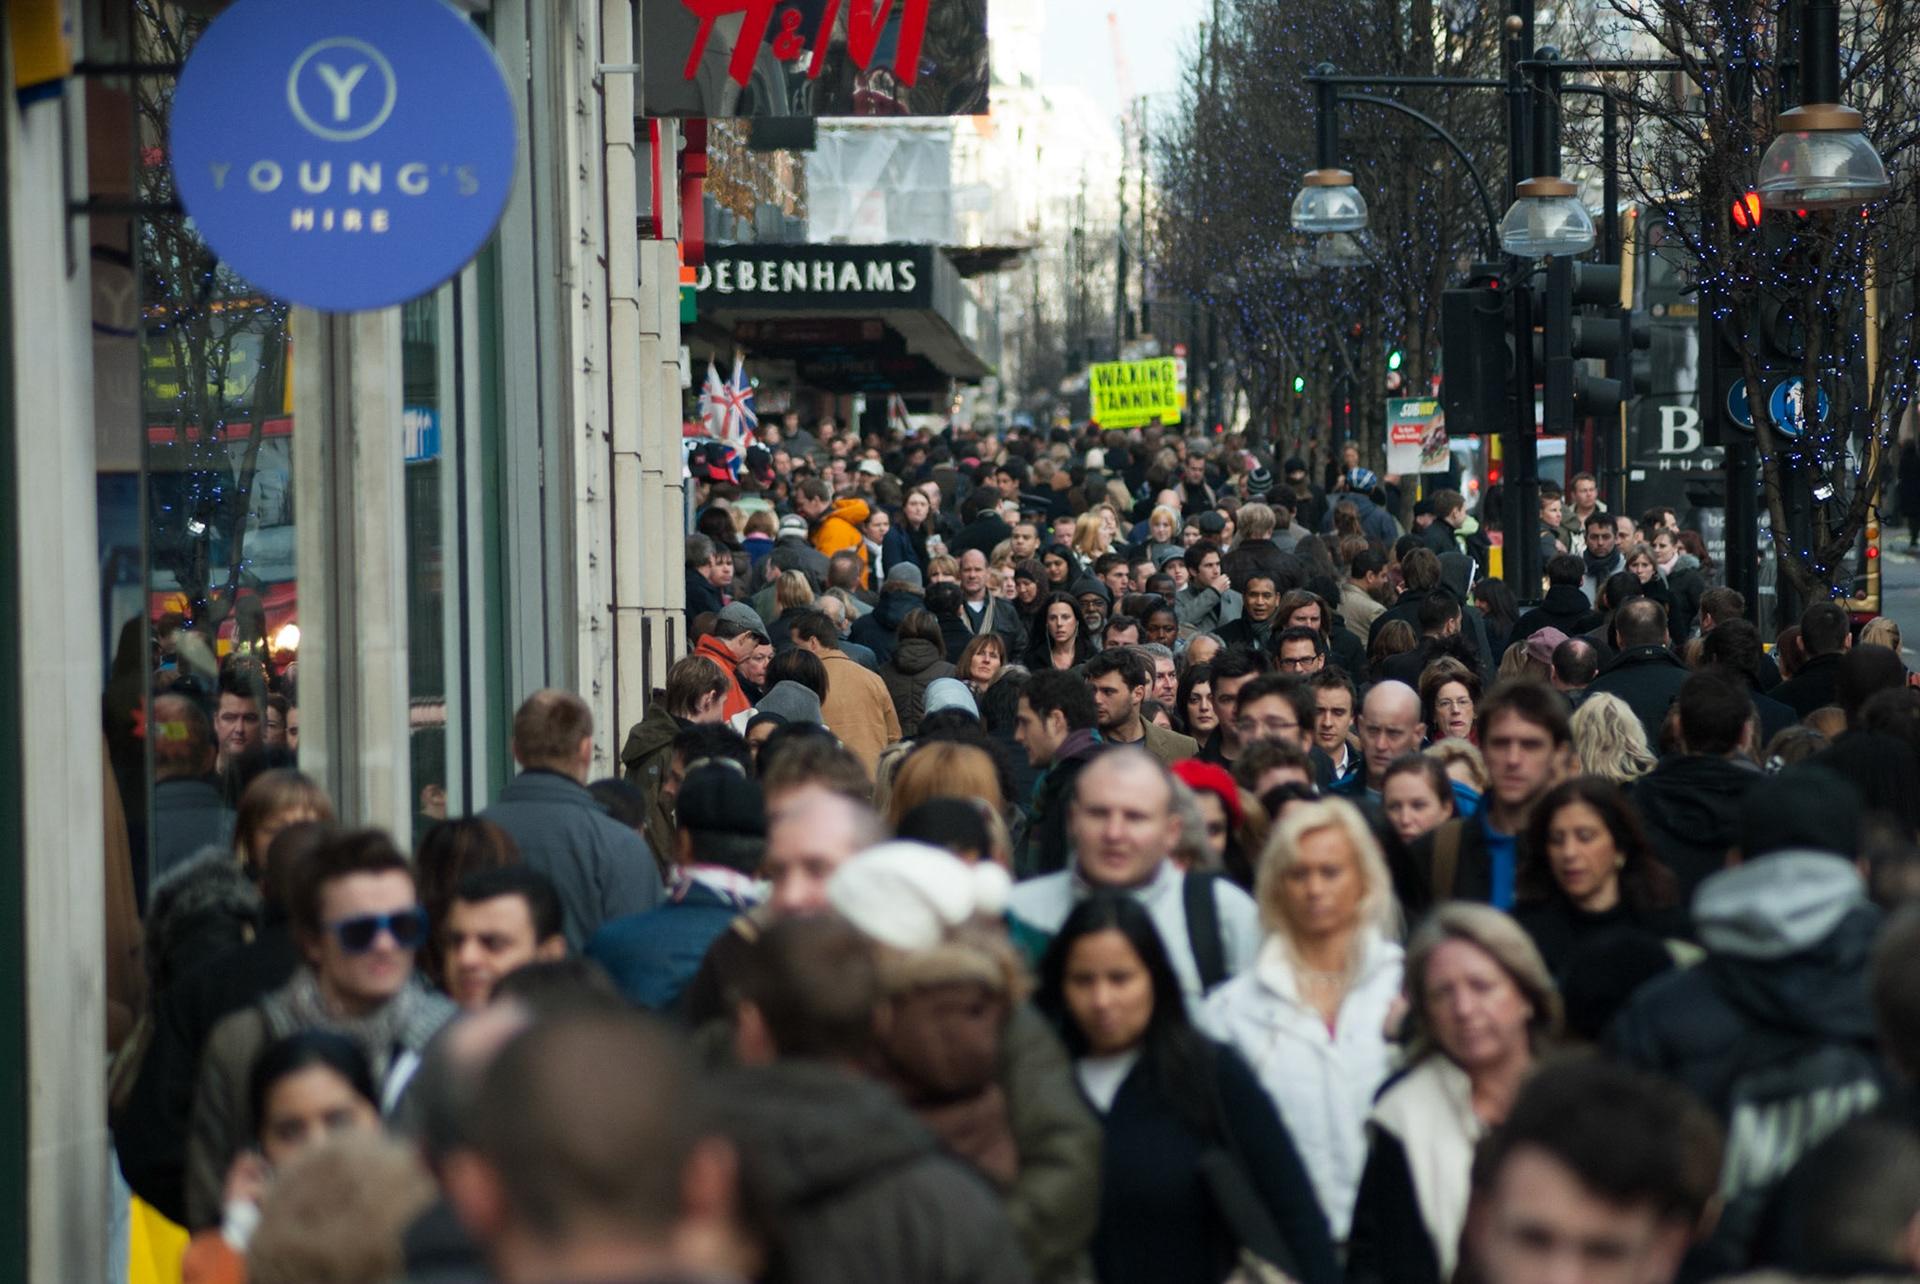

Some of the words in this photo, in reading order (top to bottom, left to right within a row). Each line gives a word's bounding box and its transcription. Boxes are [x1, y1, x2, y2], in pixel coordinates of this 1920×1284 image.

[316, 62, 370, 122] Y
[208, 159, 479, 196] YOUNG'S
[291, 207, 390, 233] HIRE
[1096, 361, 1173, 386] WAXING
[1099, 386, 1174, 411] TANNING
[1659, 458, 1714, 471] HUG
